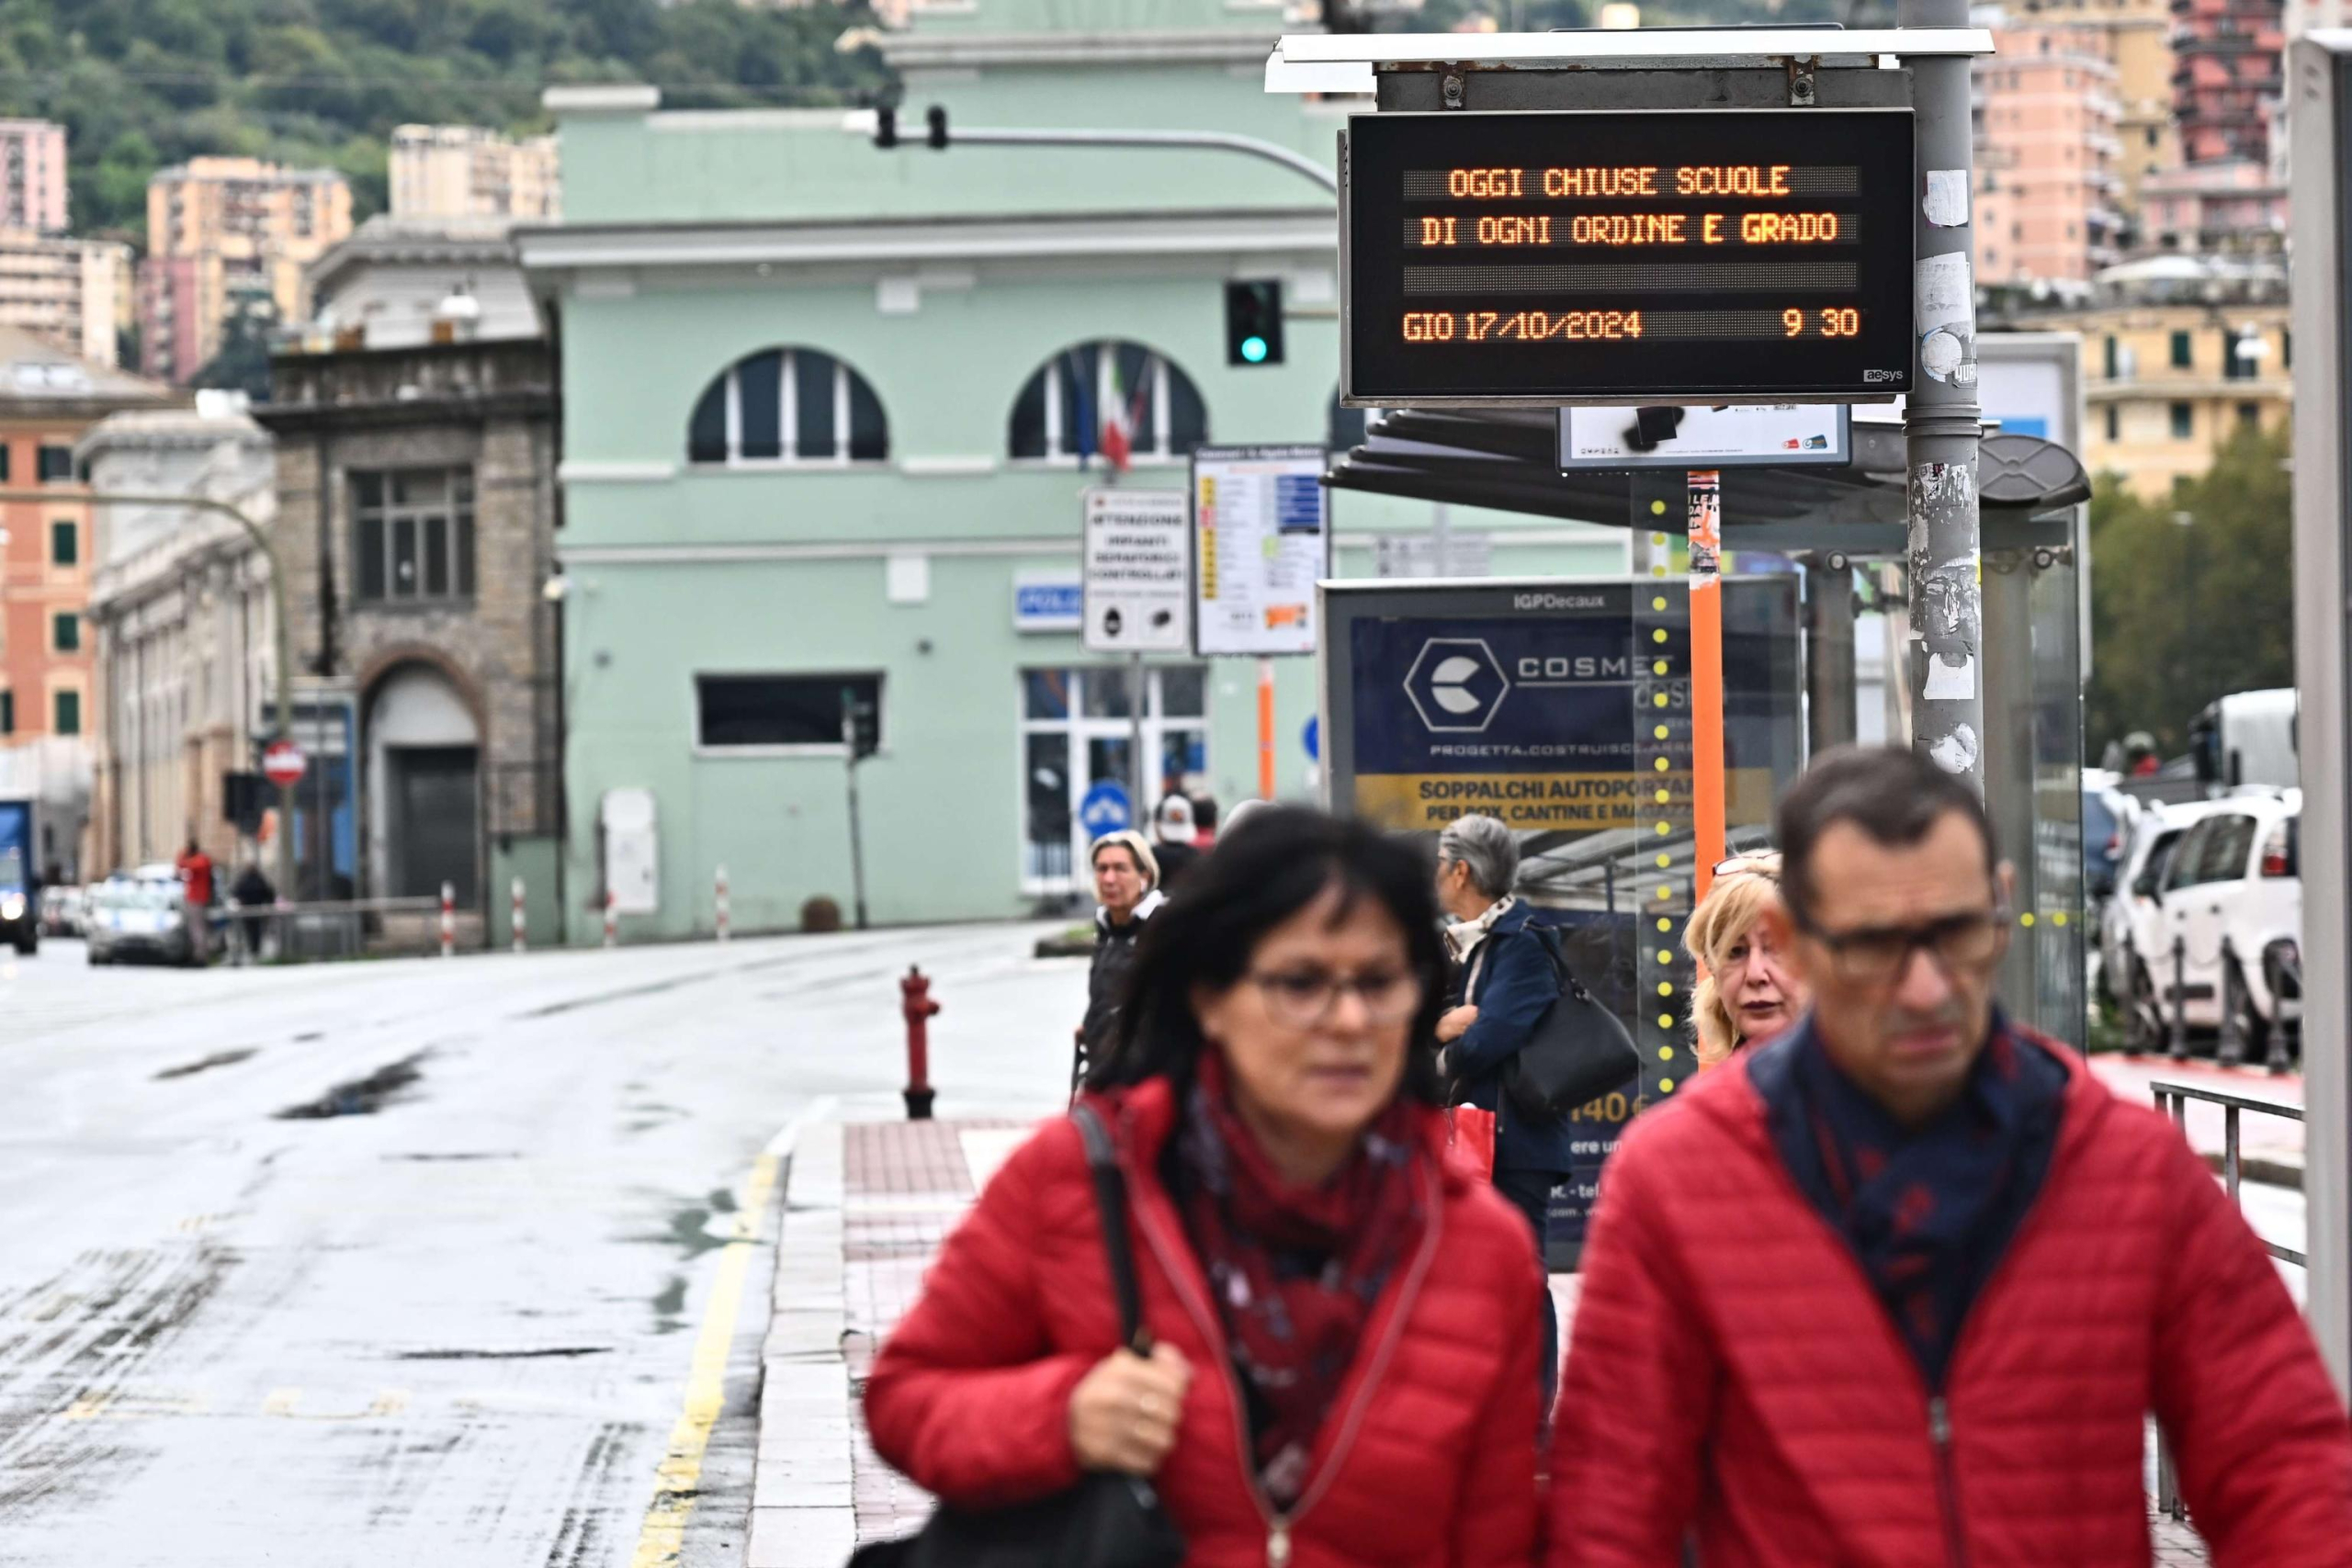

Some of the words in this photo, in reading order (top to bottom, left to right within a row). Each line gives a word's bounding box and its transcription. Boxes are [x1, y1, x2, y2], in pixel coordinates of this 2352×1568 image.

[1449, 169, 1522, 197] OGGI
[1544, 167, 1658, 197] CHIUSE
[1677, 165, 1791, 197] SCUOLE
[1420, 217, 1456, 245] DI
[1478, 215, 1552, 244] OGNI
[1572, 214, 1686, 243] ORDINE
[1702, 213, 1722, 243] E
[1742, 213, 1838, 243] GRADO
[1403, 311, 1453, 340] GIO
[1466, 310, 1643, 340] 17/10/2024
[1783, 308, 1800, 337] 9
[1820, 308, 1860, 337] 30
[1865, 369, 1904, 382] aesys
[1513, 593, 1605, 610] IGPDecaux
[1419, 780, 1544, 799] SOPPALCHI
[1426, 806, 1459, 820] PER
[1510, 804, 1593, 820] CANTINE
[1598, 805, 1607, 818] E
